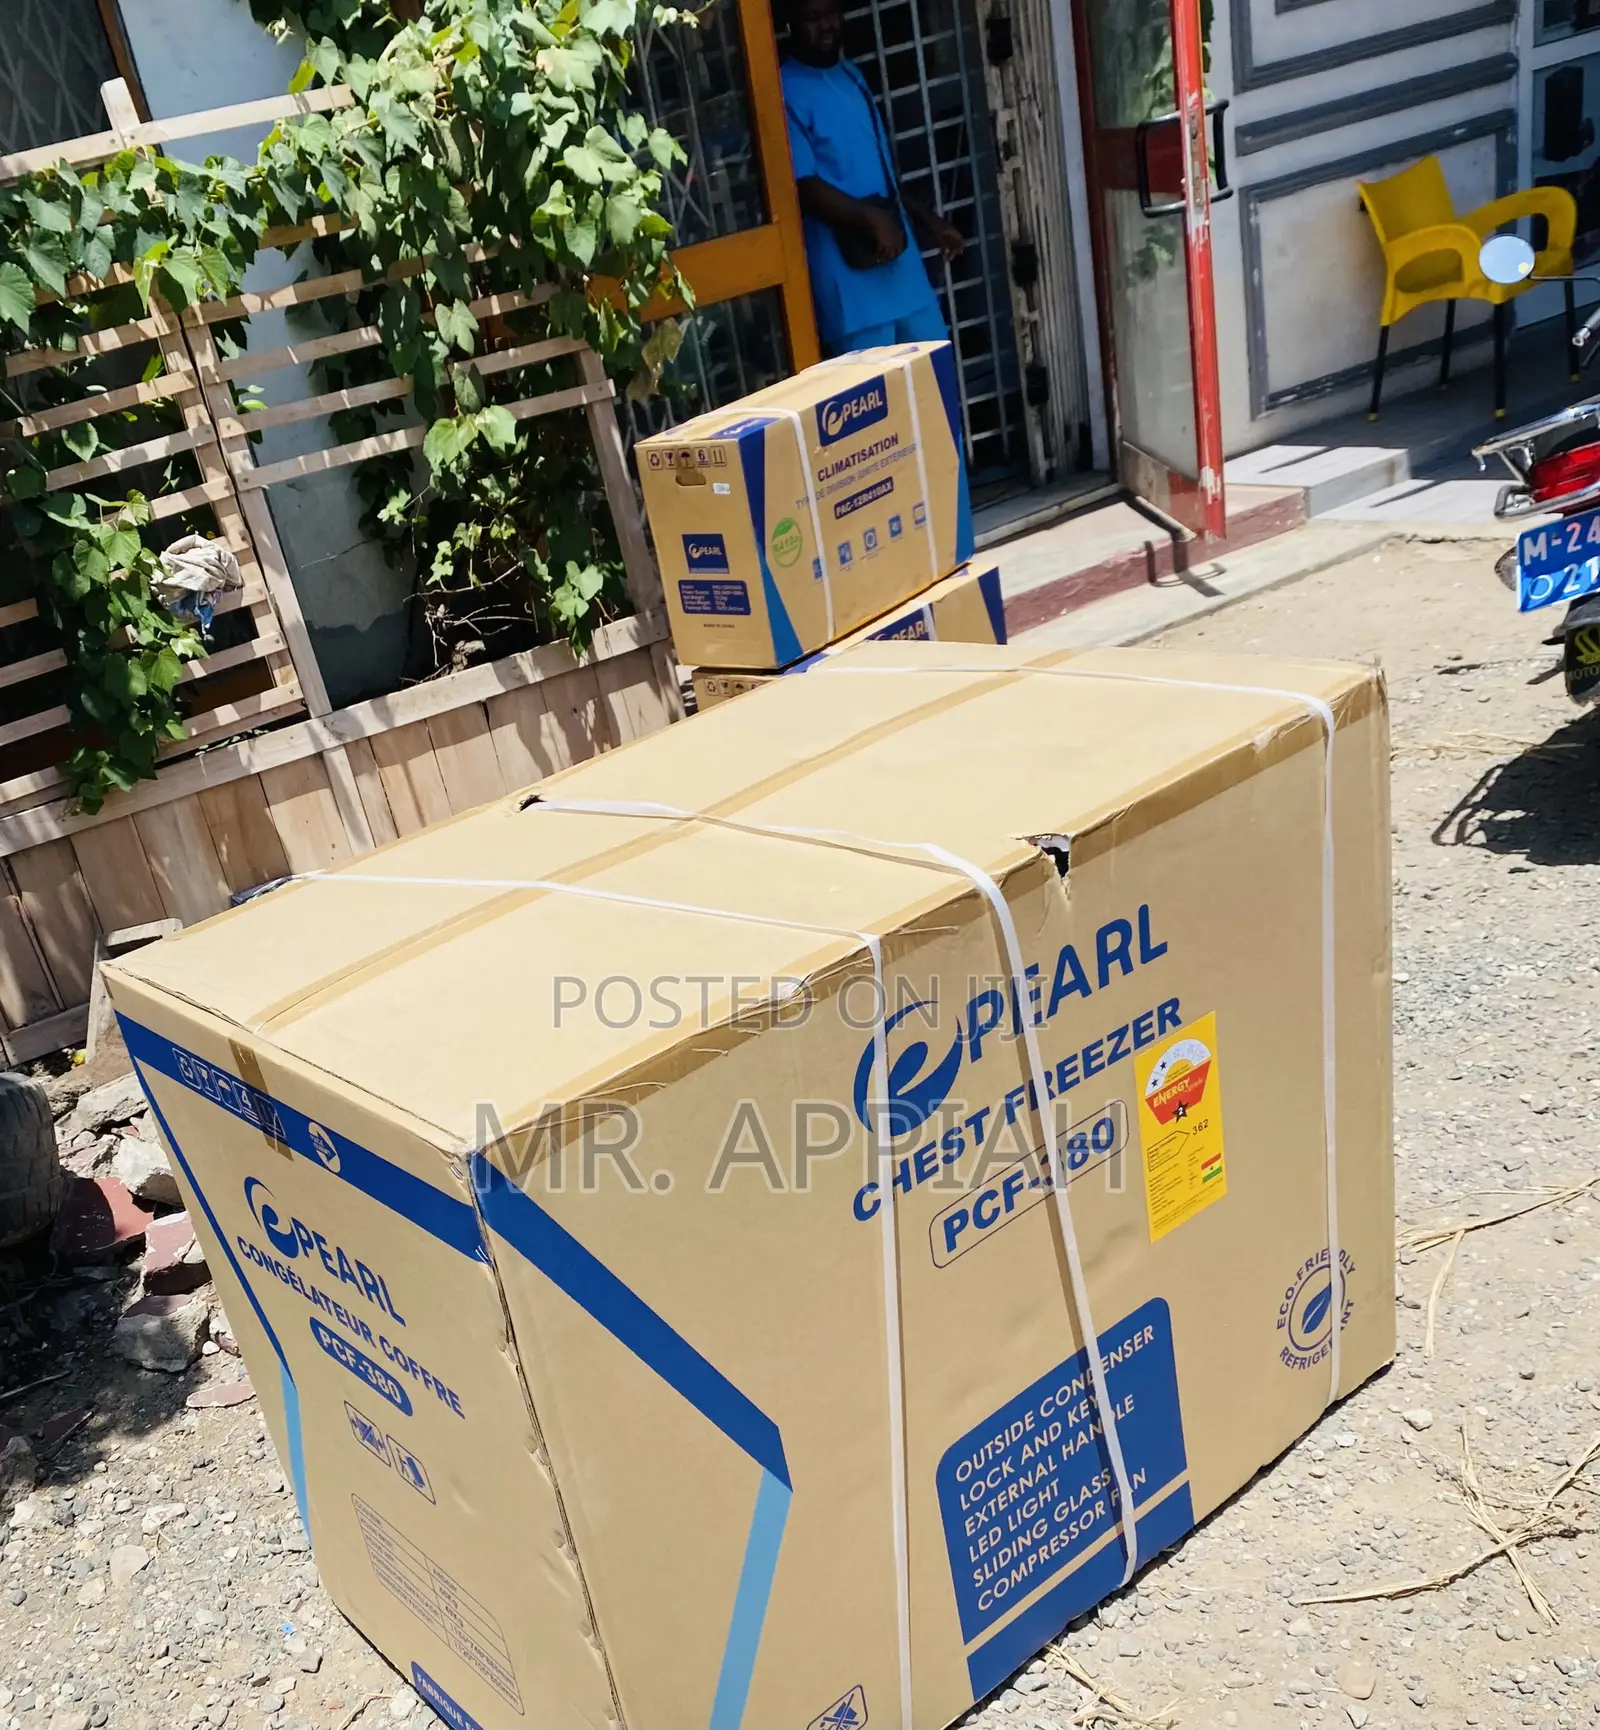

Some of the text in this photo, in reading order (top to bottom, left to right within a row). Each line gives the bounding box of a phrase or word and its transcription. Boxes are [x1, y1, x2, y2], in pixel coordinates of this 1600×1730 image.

[841, 389, 883, 421] PEARL
[817, 433, 899, 482] CLIMATISATION
[700, 546, 722, 555] PEARL
[966, 904, 1168, 1064] PEARL
[853, 997, 1183, 1222] CHEST FREEZER
[1153, 1077, 1190, 1108] ENERGY
[1192, 1119, 1209, 1136] 362
[291, 1217, 406, 1327] PEARL
[1276, 1247, 1356, 1330] ECO-FRIEDLY
[237, 1236, 465, 1420] CONGÉLATEUR COFFRE
[318, 1325, 402, 1405] PCF-380
[1279, 1299, 1354, 1371] REFRIGENT
[956, 1410, 1035, 1482] OUTSIDE
[960, 1395, 1100, 1511] LOCK AND KEY
[964, 1394, 1135, 1537] EXTERNAL HANLE
[969, 1478, 1059, 1563] LED LIGHT
[973, 1467, 1111, 1588] SLIDING GLASS
[977, 1467, 1147, 1611] COMPRESSOR FN
[417, 1672, 464, 1727] FABRIQUE
